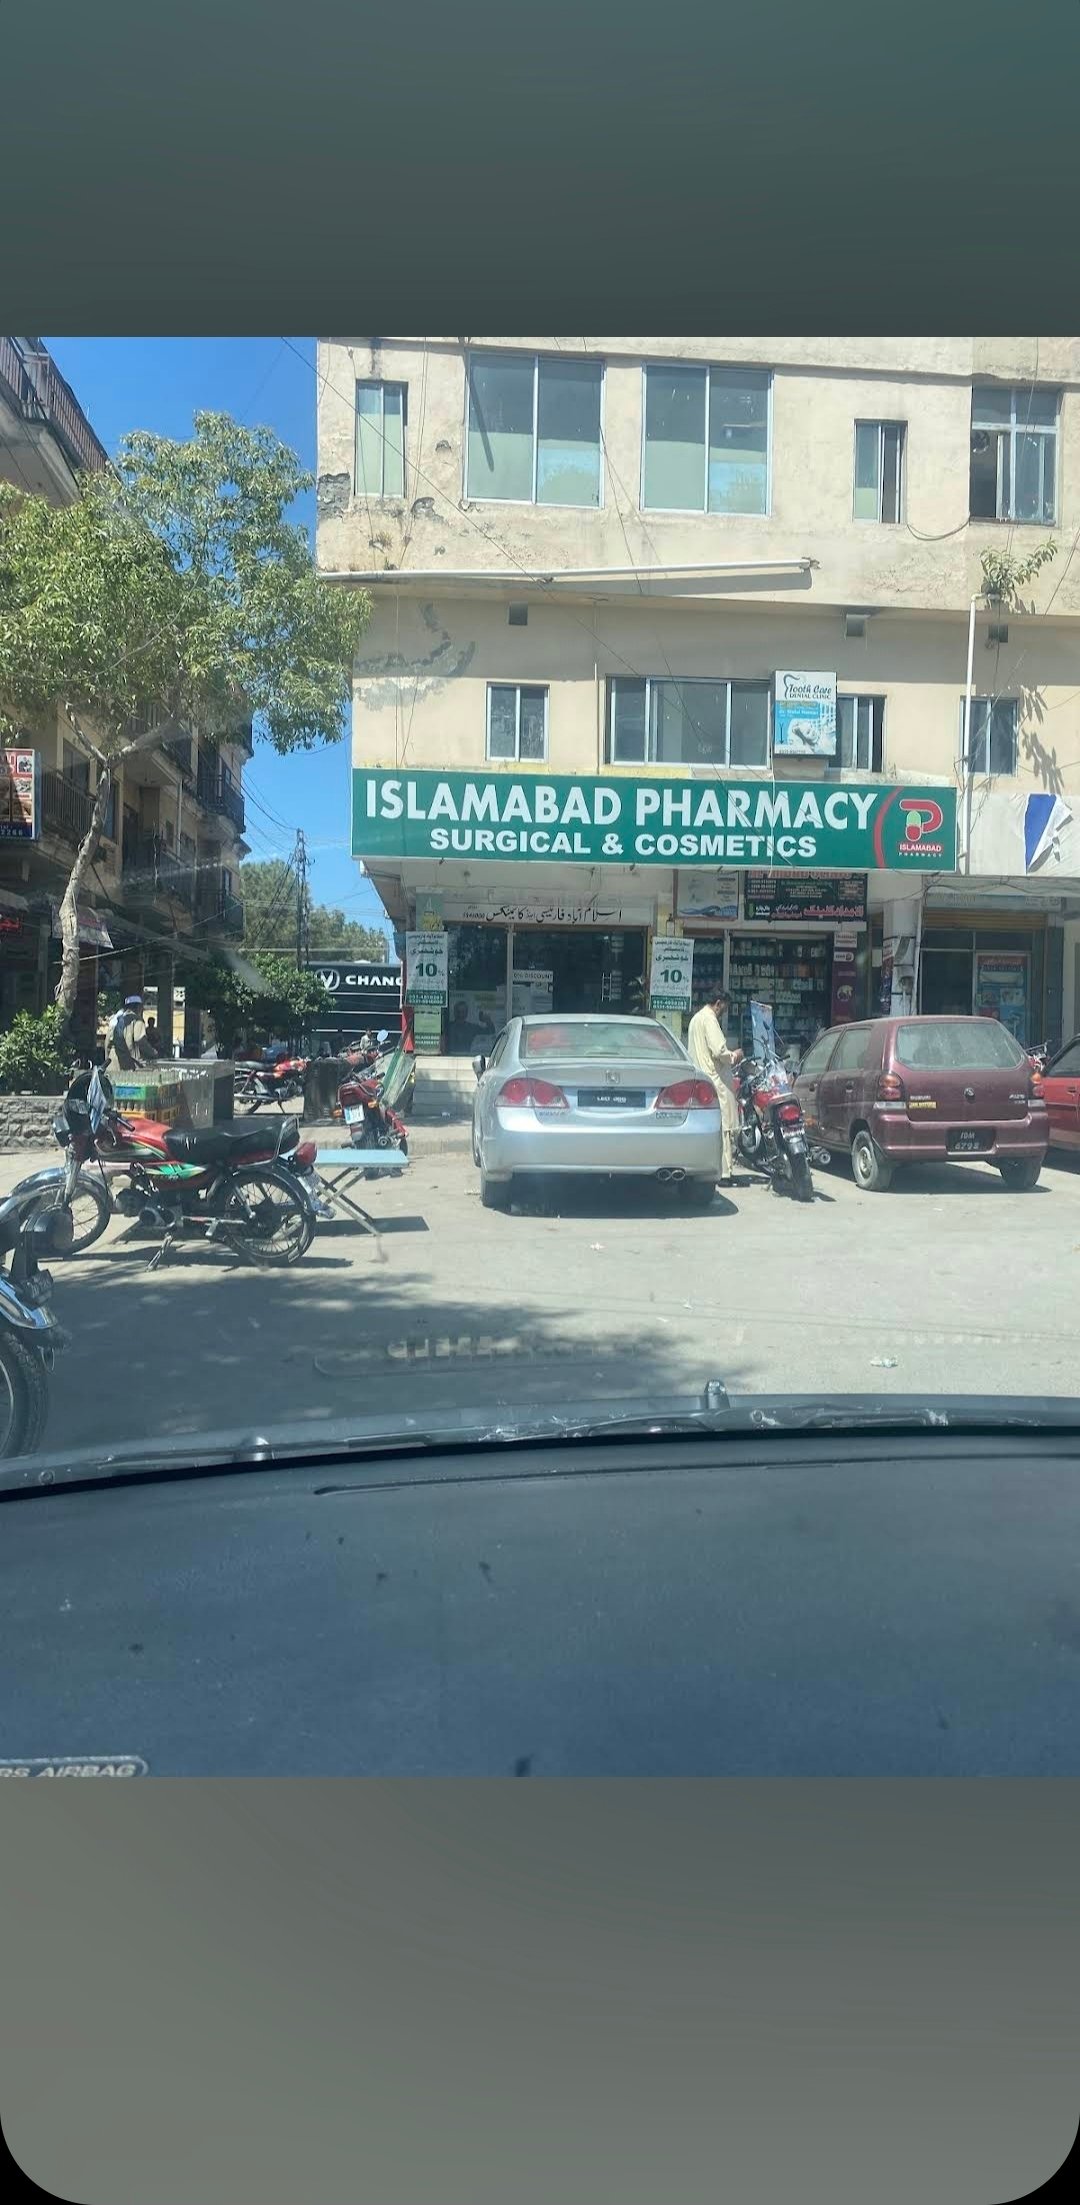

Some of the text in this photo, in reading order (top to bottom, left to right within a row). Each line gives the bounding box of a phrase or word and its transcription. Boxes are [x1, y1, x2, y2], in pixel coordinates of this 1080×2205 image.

[788, 683, 832, 695] Tooth Care
[366, 779, 878, 830] ISLAMABAD PHARMACY
[429, 828, 817, 858] SURGICAL & COSMETICS
[899, 843, 942, 853] ISLAMABAD
[35, 1764, 136, 1777] AIRBAG
